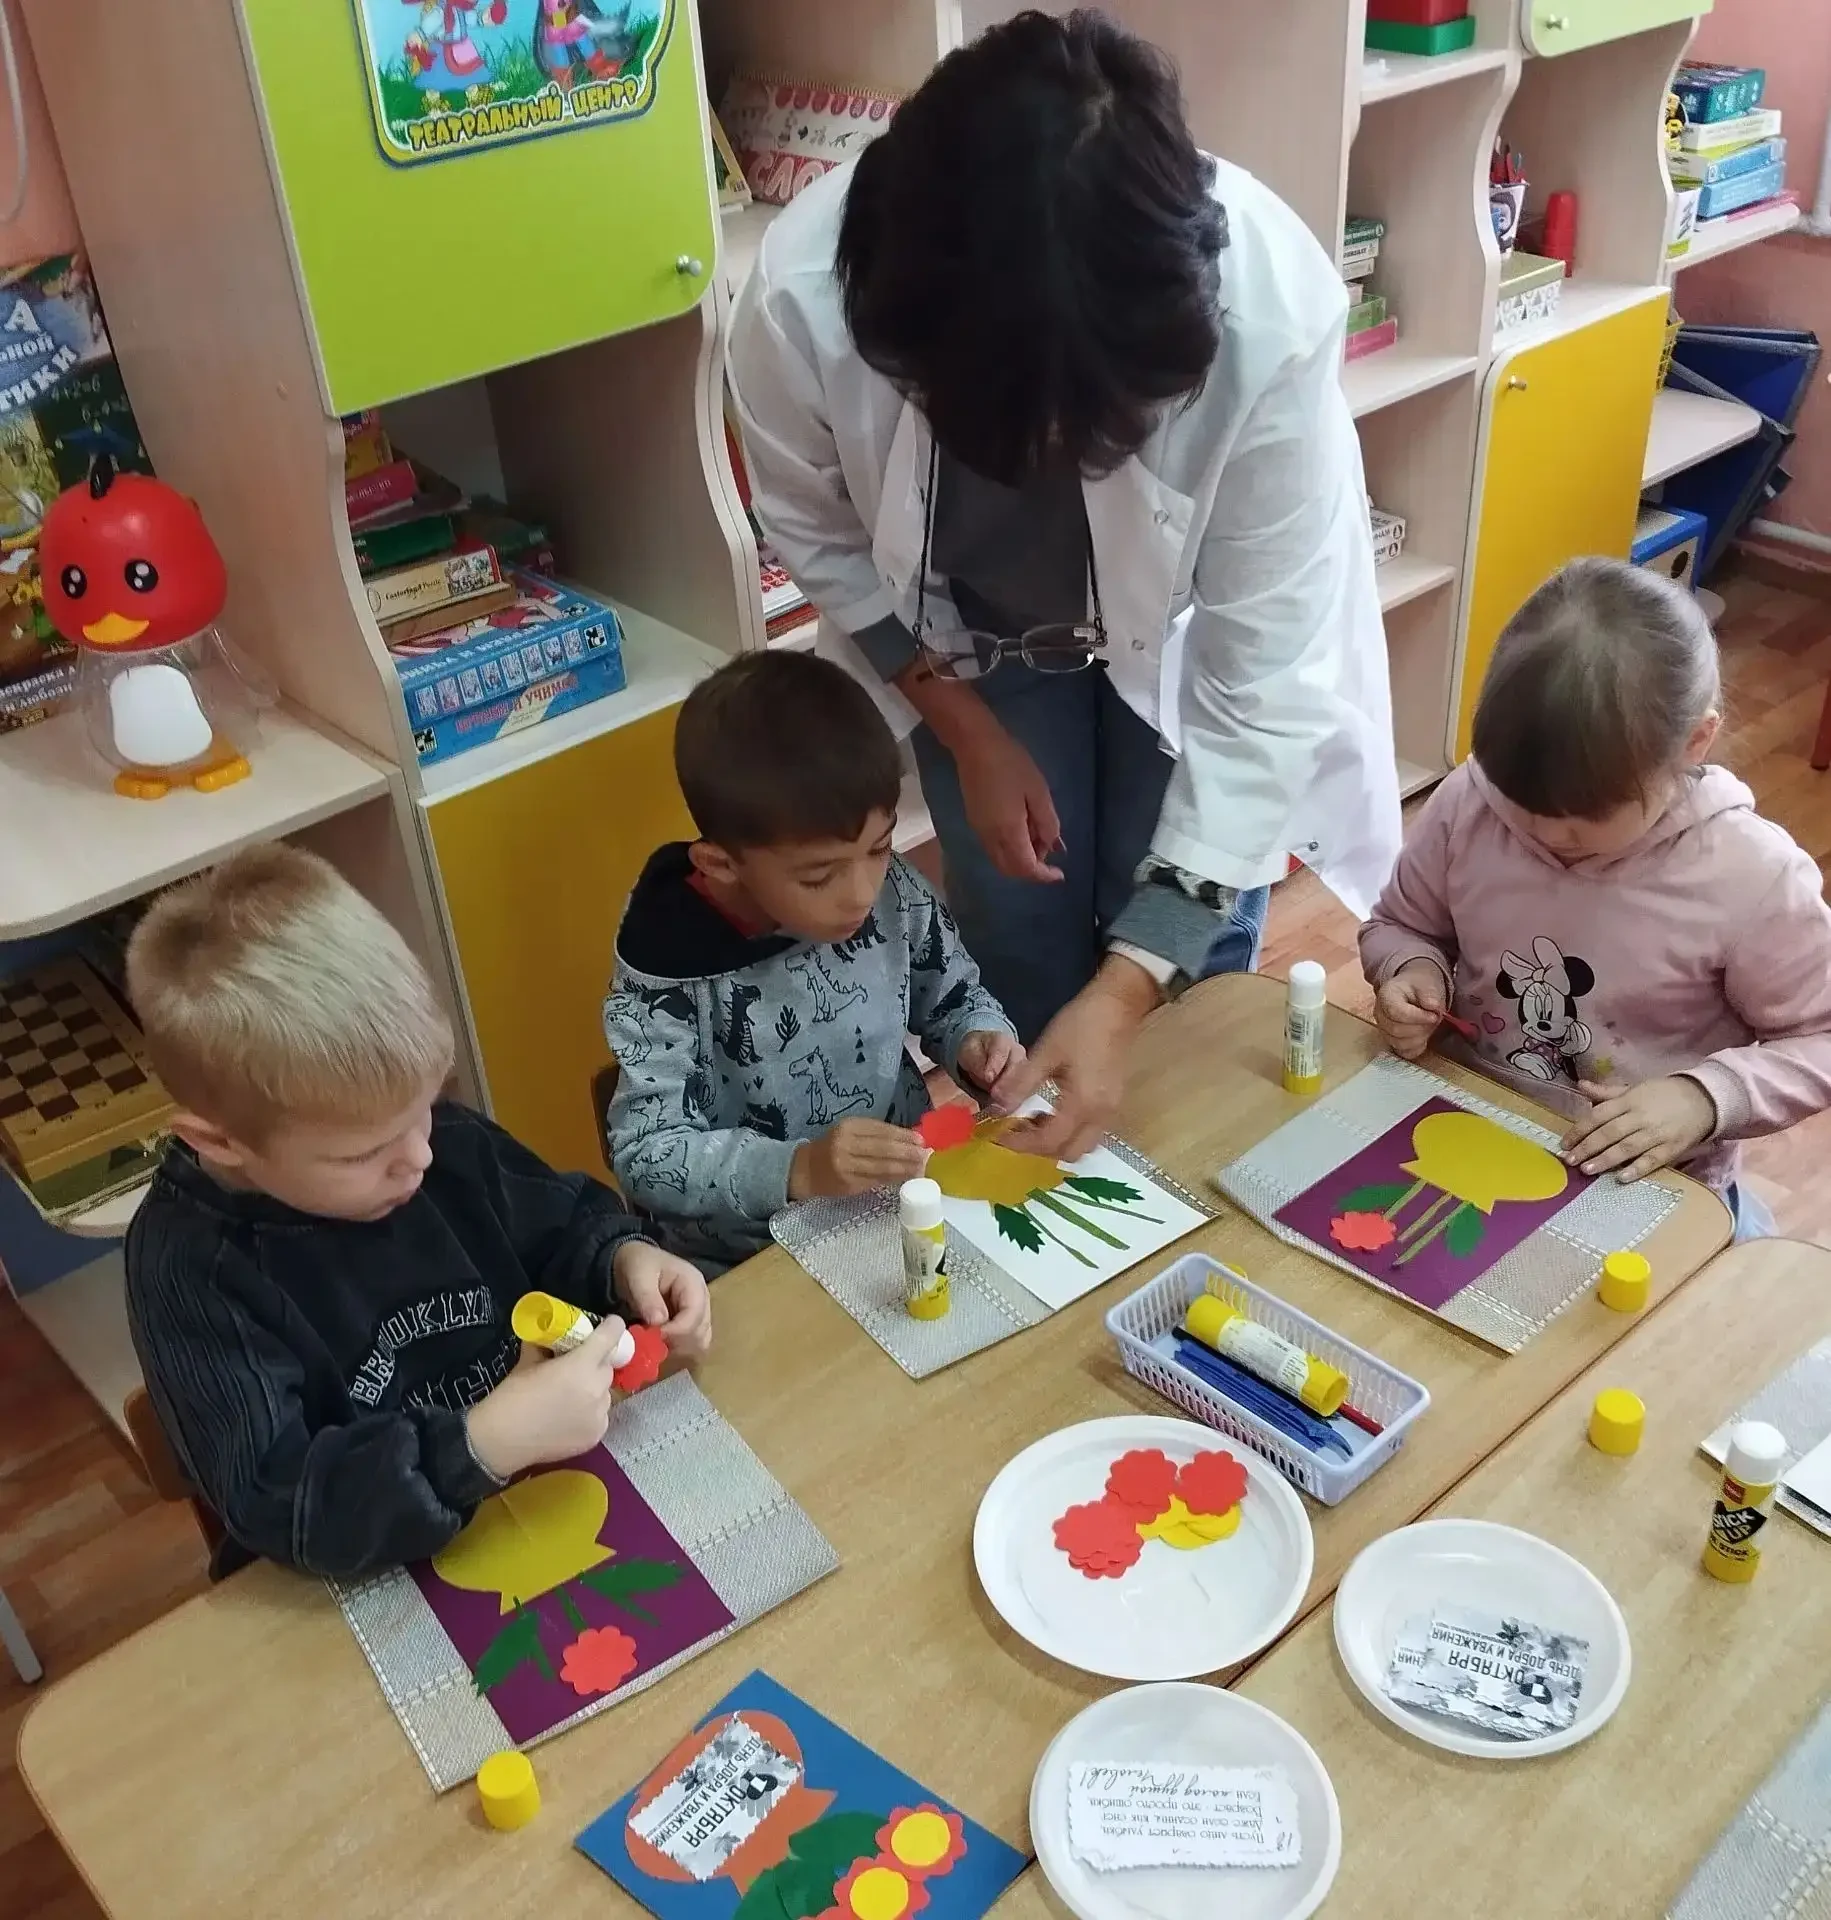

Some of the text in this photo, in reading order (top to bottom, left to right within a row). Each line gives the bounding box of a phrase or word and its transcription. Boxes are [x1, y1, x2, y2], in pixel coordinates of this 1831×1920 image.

[409, 77, 638, 150] ТЕАТРАЛЬНЫЙ ЦЕНТР
[1726, 1524, 1752, 1540] UP
[1431, 1627, 1494, 1654] УВАЖЕНИЯ
[1496, 1648, 1505, 1659] И
[1507, 1652, 1546, 1670] ДОБРА
[1447, 1650, 1526, 1685] ОКТЯБРЯ
[1549, 1661, 1580, 1679] ДЕНЬ
[735, 1736, 761, 1763] ДЕНЬ
[707, 1759, 739, 1794] ДОБРА
[698, 1790, 709, 1803] И
[1236, 1790, 1261, 1802] Если
[1136, 1800, 1178, 1810] просто
[1181, 1802, 1201, 1811] это
[1214, 1801, 1262, 1817] Возраст
[653, 1796, 704, 1848] УВАЖЕНИЯ
[682, 1785, 746, 1848] ОКТЯБРЯ
[1200, 1830, 1227, 1839] лицо
[1230, 1832, 1264, 1843] Пусть
